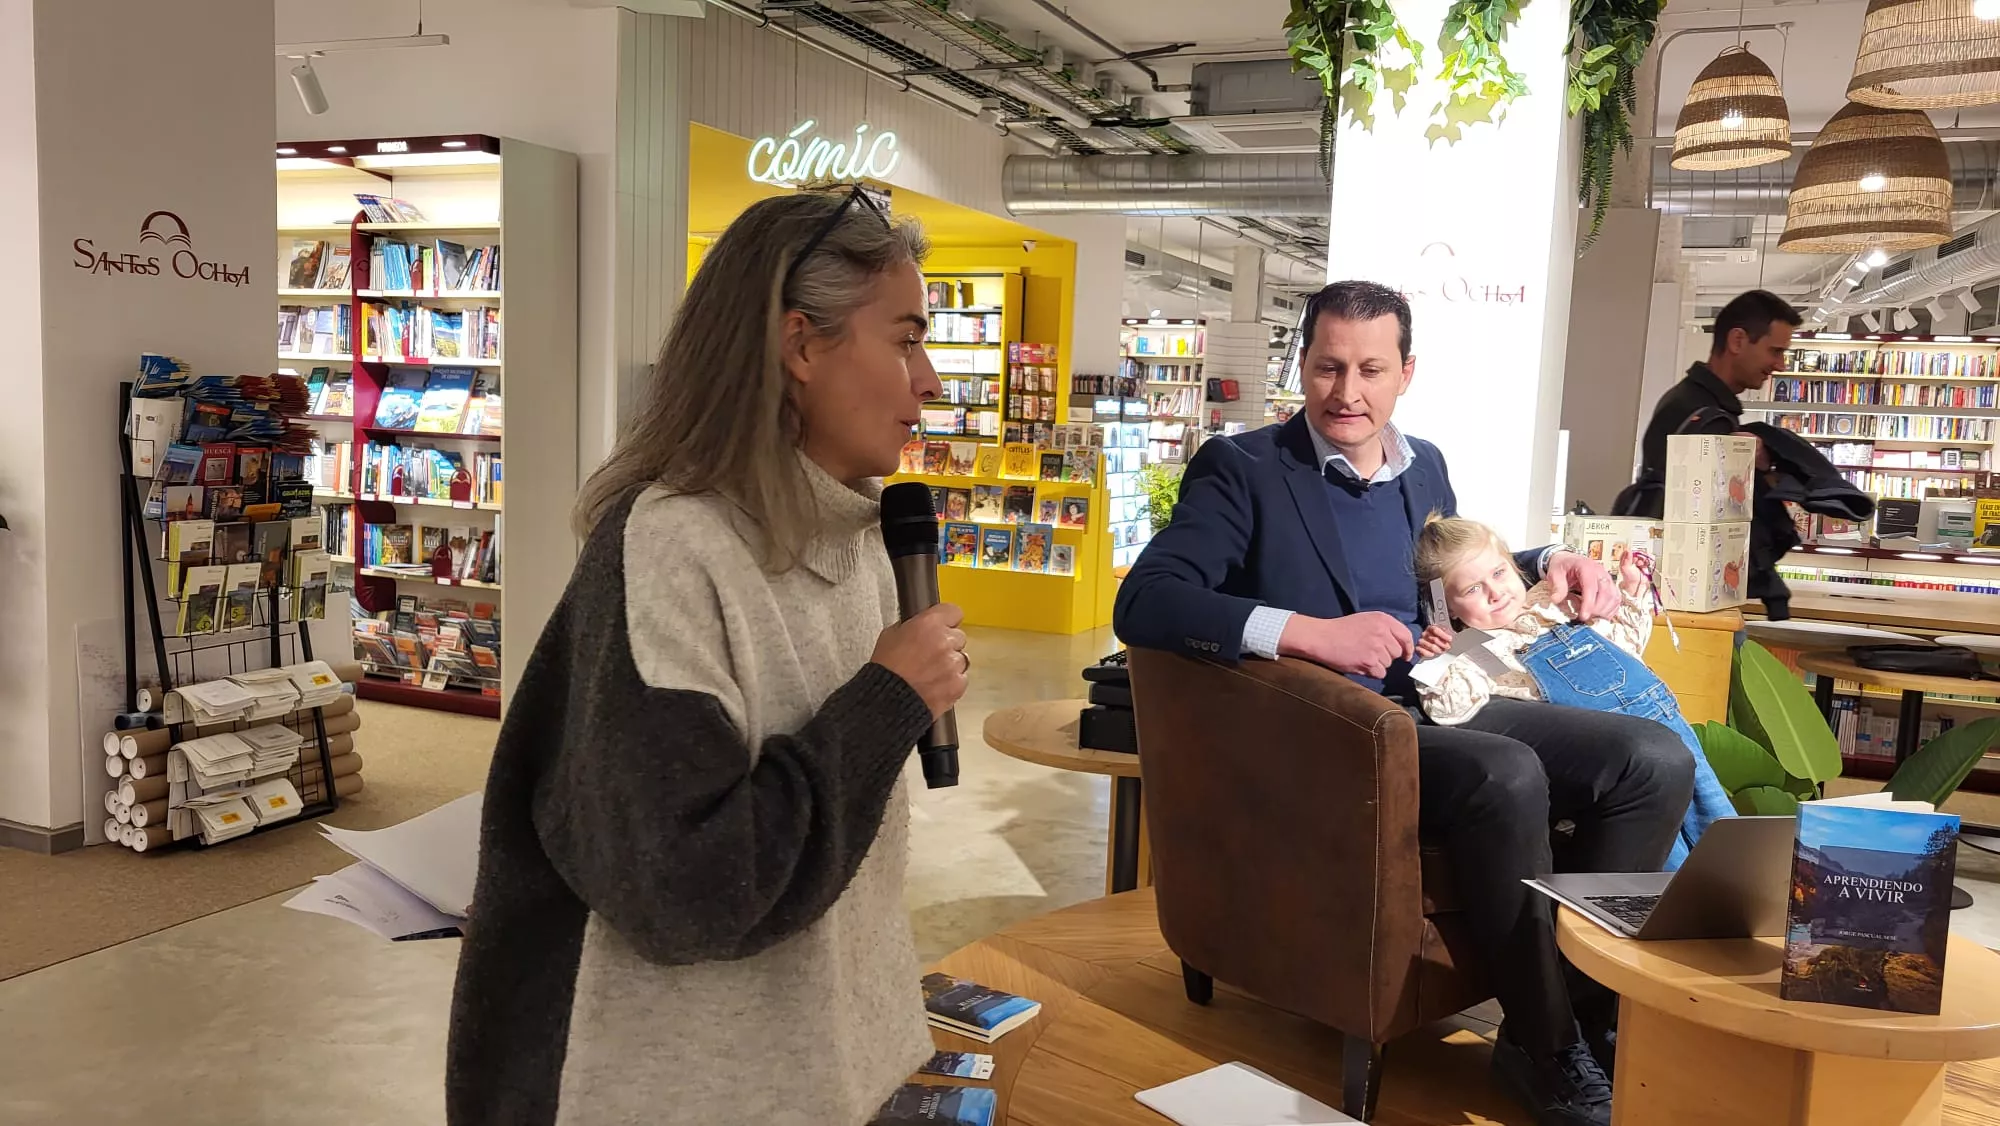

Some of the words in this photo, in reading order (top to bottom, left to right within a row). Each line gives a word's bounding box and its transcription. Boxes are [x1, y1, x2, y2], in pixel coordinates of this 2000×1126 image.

[748, 119, 900, 182] cómic
[1586, 522, 1610, 531] JEKCA
[1823, 874, 1923, 893] APRENDIENDO
[1839, 886, 1850, 898] A
[1856, 887, 1905, 904] VIVIR
